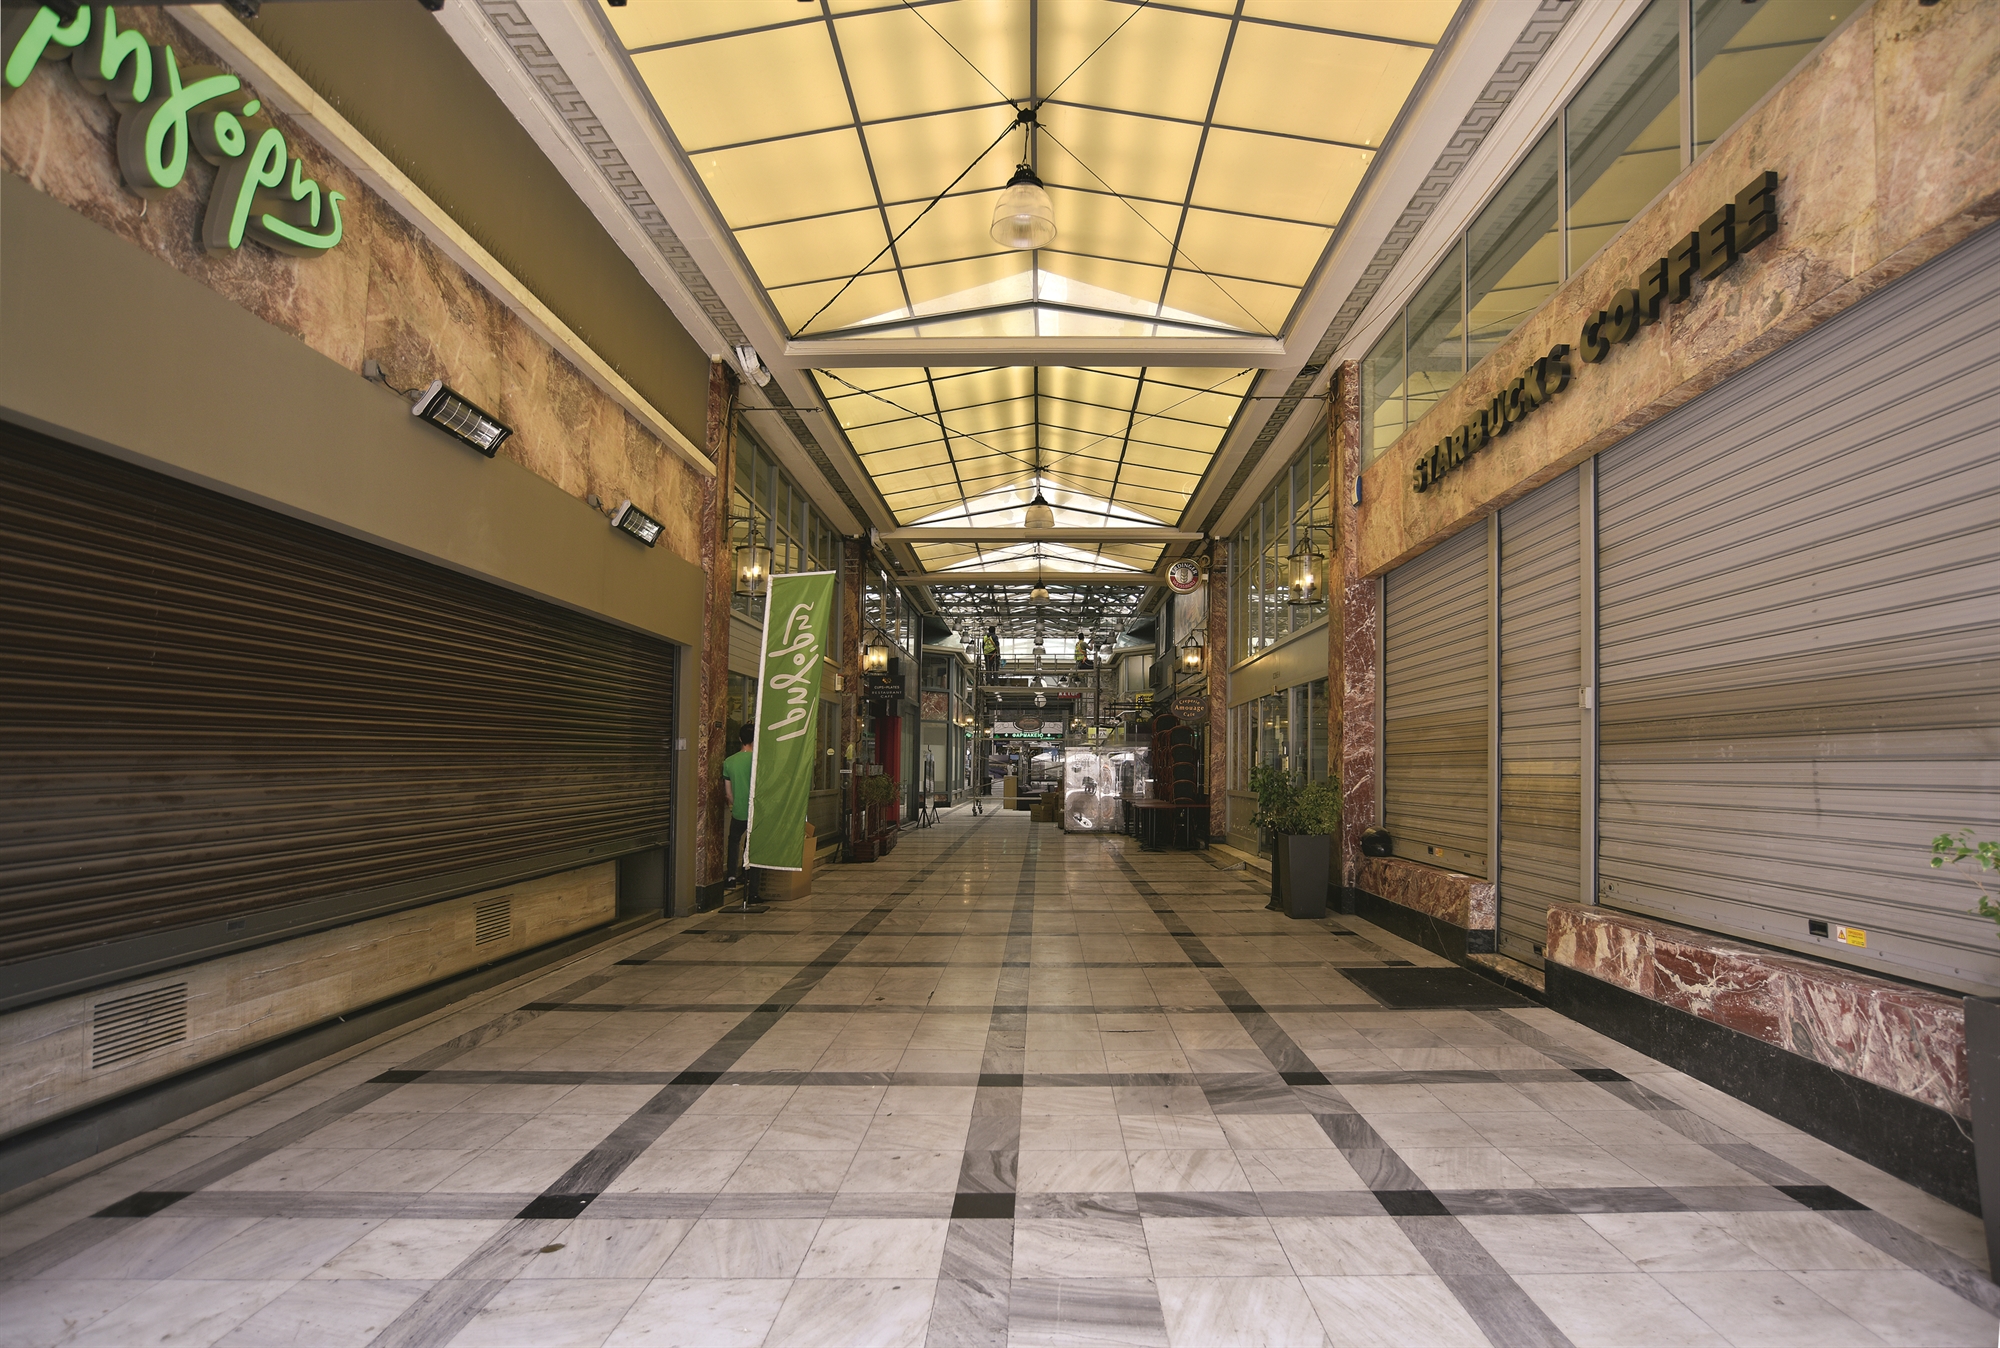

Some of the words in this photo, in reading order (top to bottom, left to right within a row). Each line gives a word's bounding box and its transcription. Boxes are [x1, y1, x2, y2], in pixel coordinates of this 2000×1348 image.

[1412, 343, 1571, 493] STARBUCKS
[1580, 170, 1778, 363] COFFEE
[1172, 563, 1198, 574] ERDINGER
[767, 601, 819, 742] Γρηγόρης
